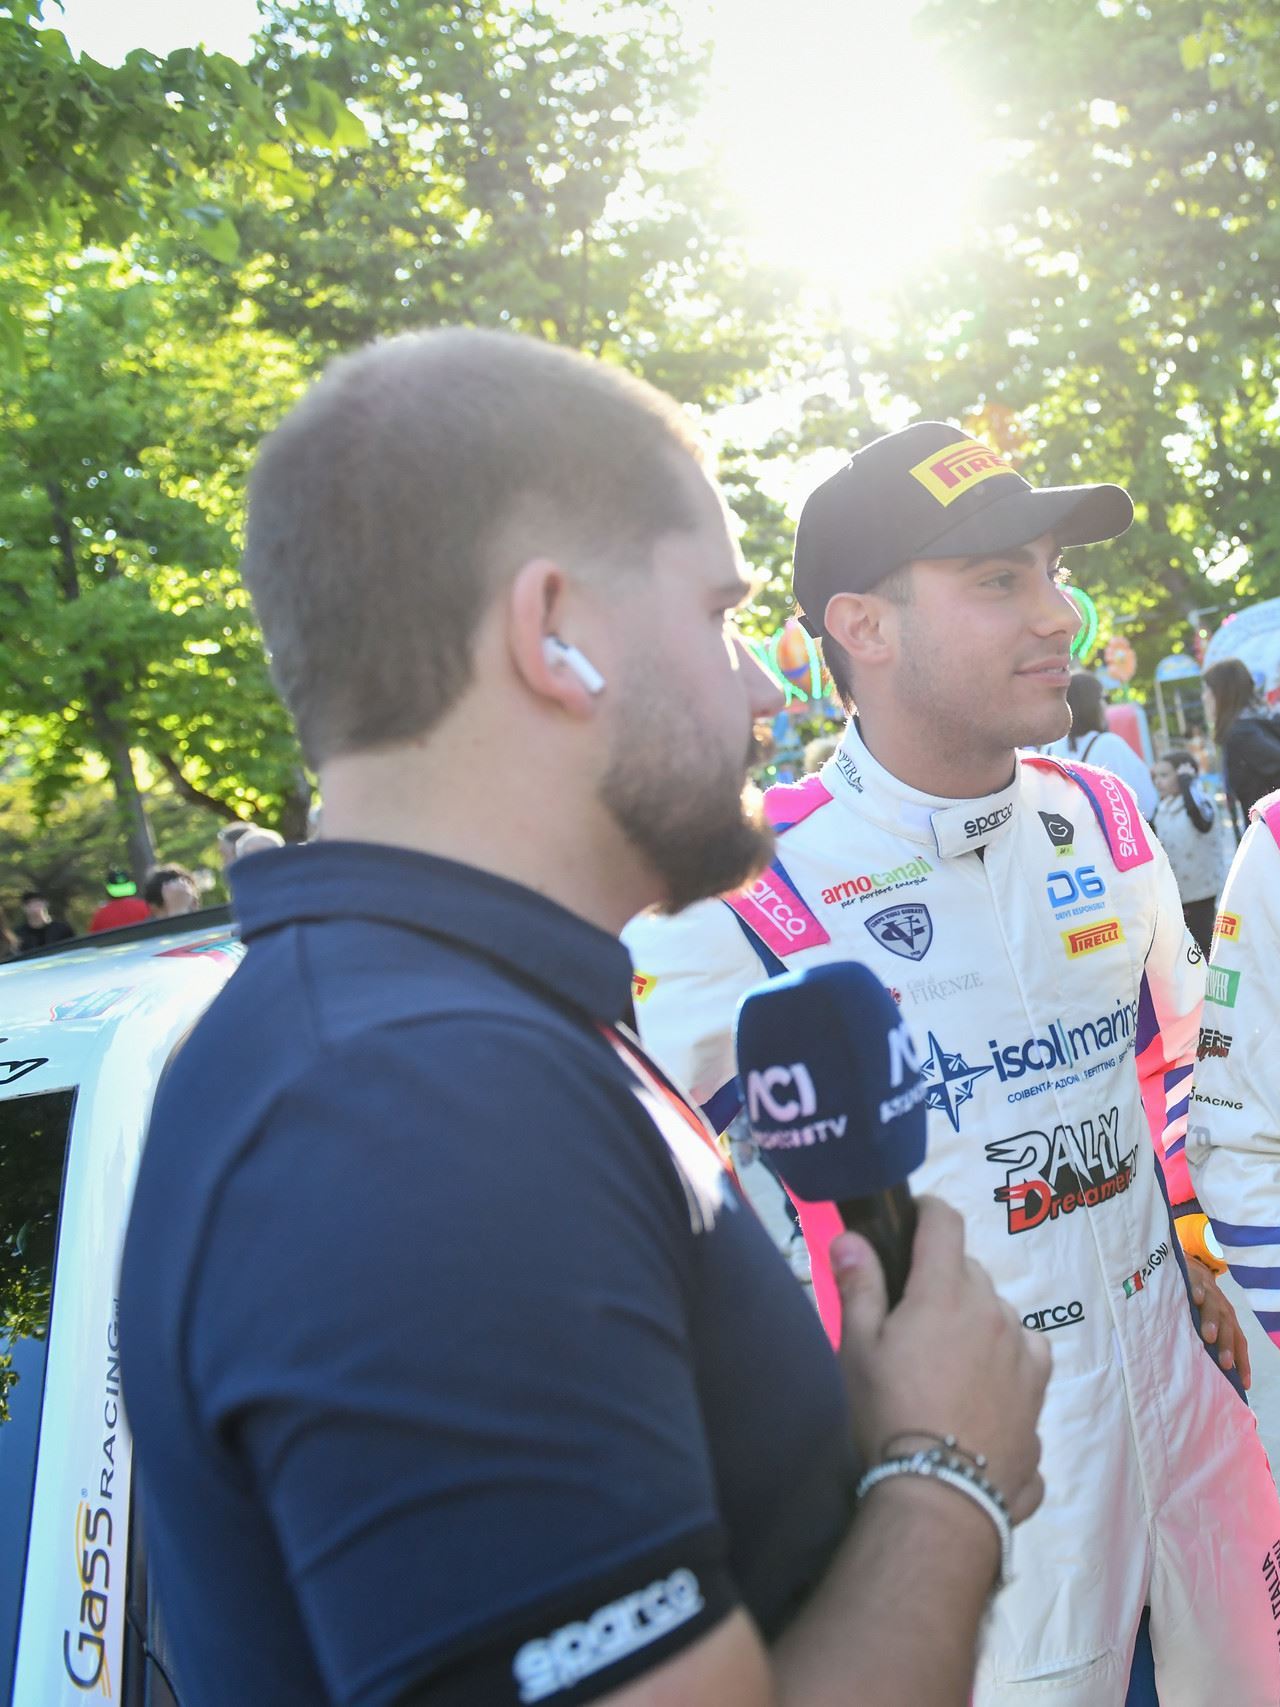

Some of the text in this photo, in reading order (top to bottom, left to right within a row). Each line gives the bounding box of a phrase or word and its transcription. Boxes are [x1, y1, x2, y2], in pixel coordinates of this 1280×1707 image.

[964, 803, 1014, 839] sparco
[1101, 774, 1139, 858] sparco
[743, 879, 807, 942] arco
[1068, 922, 1119, 954] PIRELLI
[909, 972, 984, 1005] FIRENZE
[1195, 1094, 1244, 1110] RACING
[1022, 1301, 1086, 1333] arco
